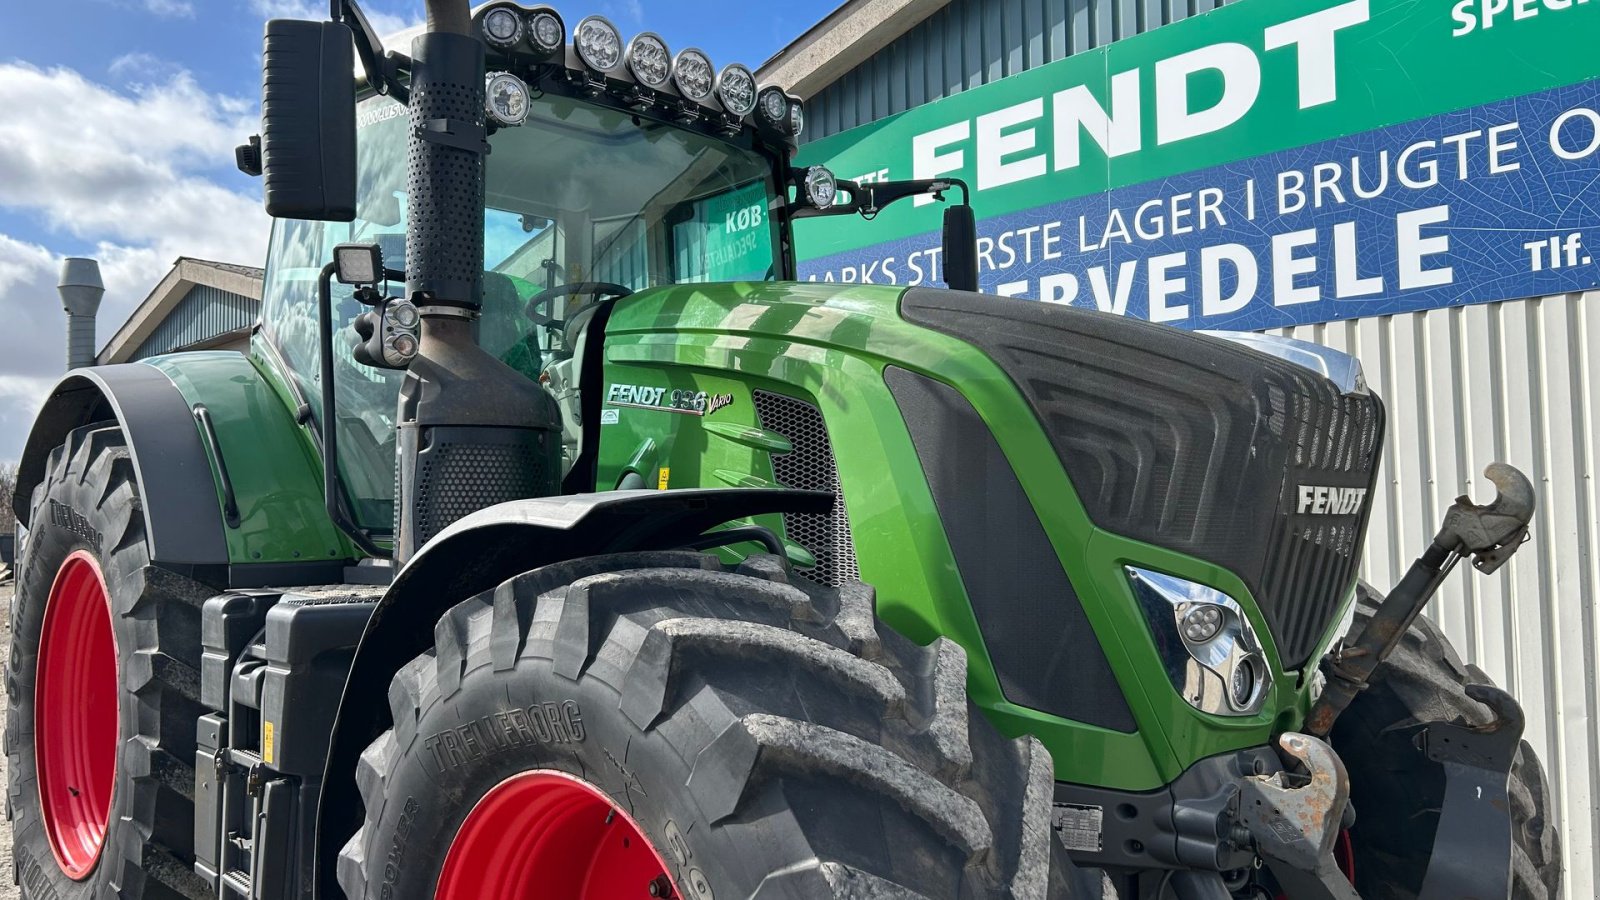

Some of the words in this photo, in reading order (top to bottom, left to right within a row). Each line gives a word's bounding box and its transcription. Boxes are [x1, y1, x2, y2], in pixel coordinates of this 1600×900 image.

[913, 0, 1370, 208] FENDT
[908, 221, 1061, 286] STRSTE
[1079, 187, 1227, 252] LAGER
[1246, 179, 1255, 221] I
[1277, 122, 1520, 215] BRUGTE
[996, 204, 1453, 324] RVEDELE
[1523, 232, 1591, 272] Tlf.
[606, 383, 667, 407] FENDT
[669, 389, 709, 412] 936
[1297, 484, 1367, 515] FENDT
[424, 699, 586, 773] TRELLEBORG
